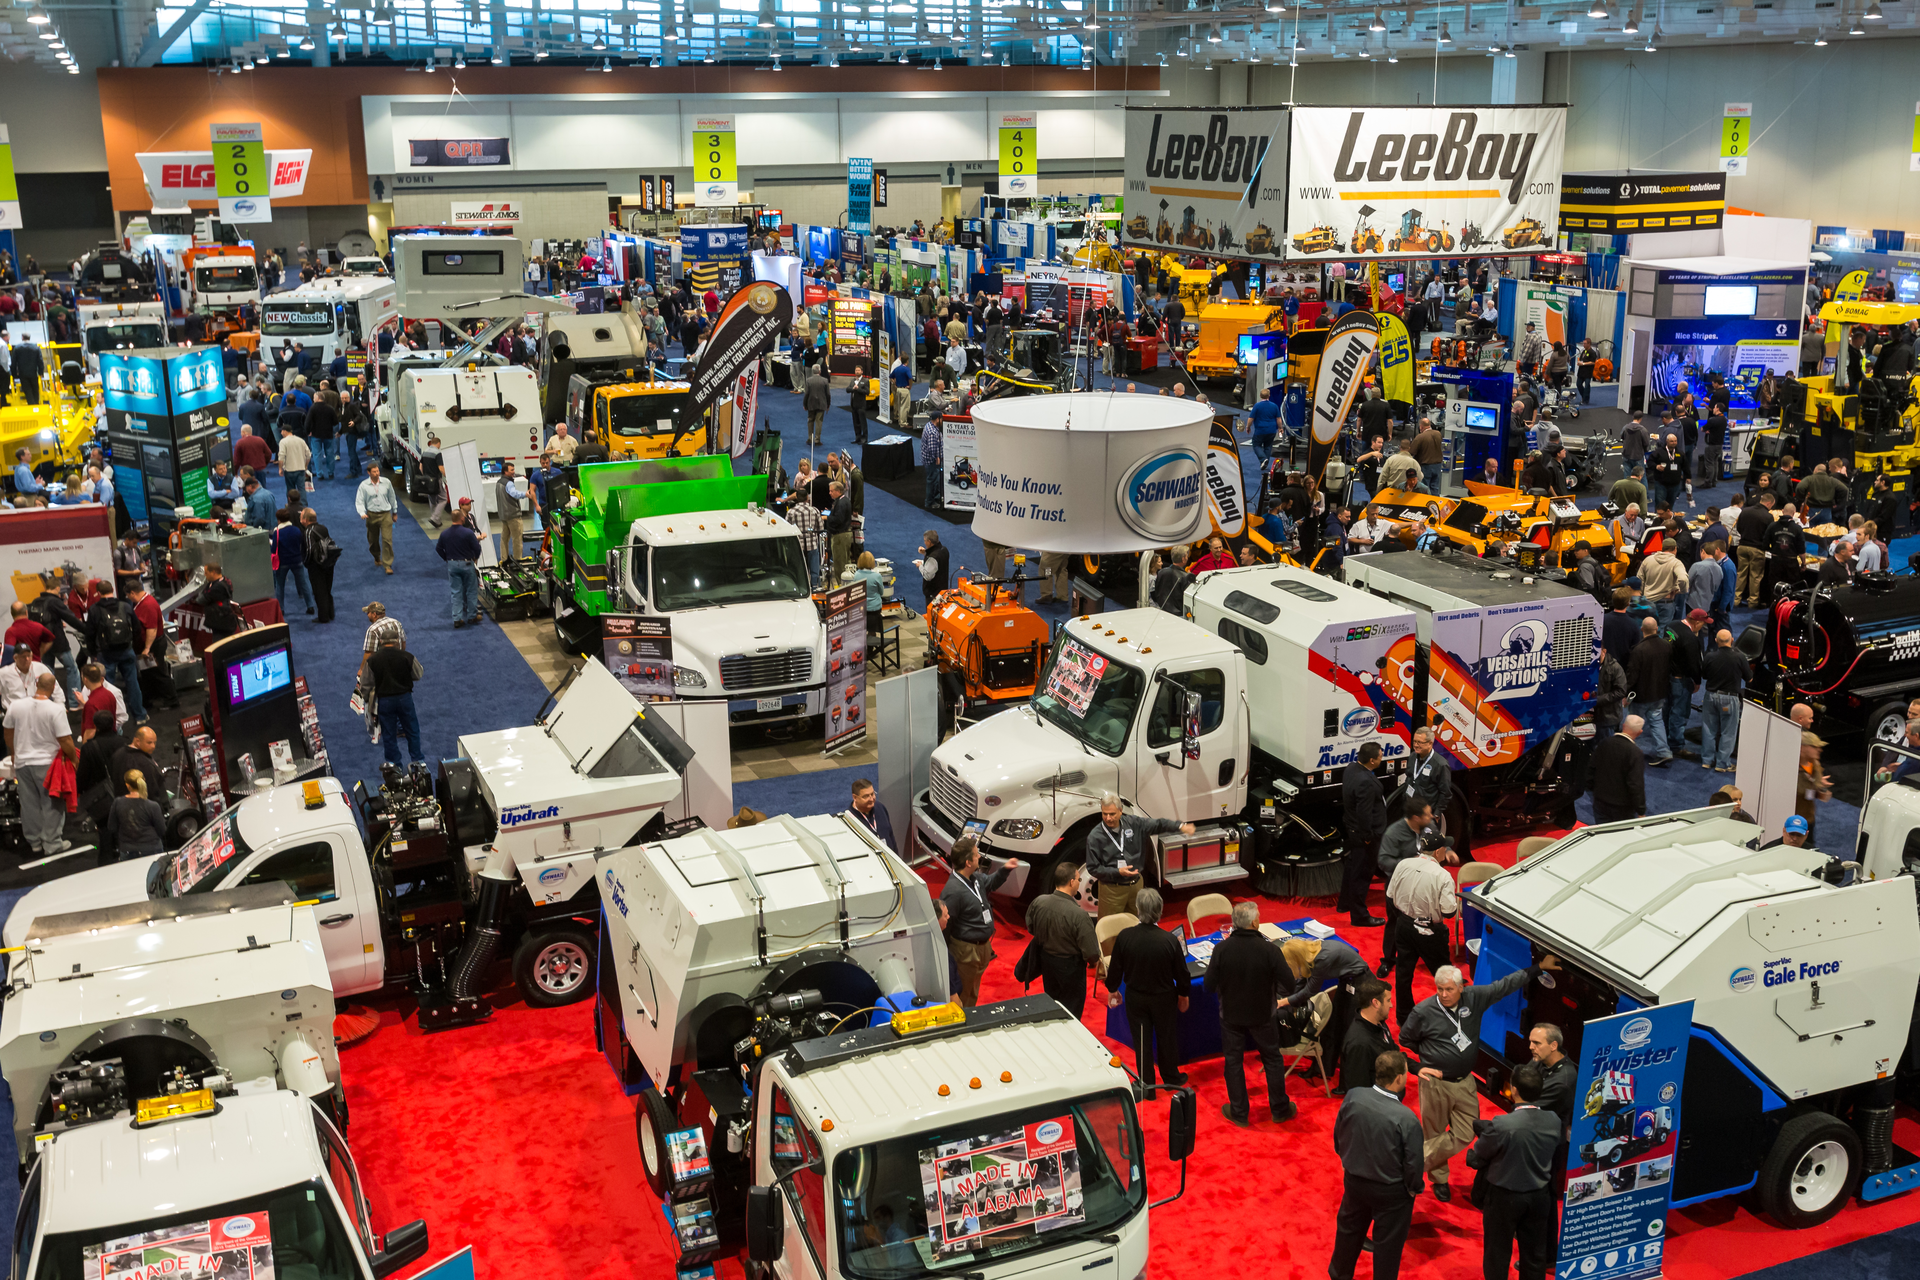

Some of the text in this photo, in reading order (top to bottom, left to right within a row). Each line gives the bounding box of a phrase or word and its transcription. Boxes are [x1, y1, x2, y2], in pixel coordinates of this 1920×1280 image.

[444, 141, 484, 159] QPR
[708, 134, 721, 180] 300
[1012, 130, 1023, 173] 400
[1333, 112, 1538, 204] LeeBoy
[231, 144, 250, 194] 200
[849, 158, 872, 166] WIN
[1145, 113, 1268, 208] LeeBoy
[161, 164, 216, 188] ELG
[273, 160, 305, 186] ELGIN
[397, 175, 434, 184] WOMEN
[849, 172, 871, 180] WORK
[645, 181, 654, 211] CASE
[664, 181, 674, 211] CASE
[850, 183, 872, 191] SAVE
[879, 174, 887, 205] CASE
[1260, 187, 1281, 201] .com
[1300, 187, 1334, 200] www.
[1525, 181, 1554, 195] .com
[455, 211, 520, 220] STEWART-AMOS
[1031, 272, 1059, 280] NEYRA
[1533, 292, 1557, 300] Billy Goat
[267, 312, 328, 323] NEW Chassis!
[1844, 308, 1869, 316] BOMAG
[1675, 332, 1719, 341] Nice Stripes.
[695, 316, 781, 403] HEAT DESIGN EQUIPMENT INC.
[1382, 339, 1410, 369] 25
[1315, 335, 1371, 423] LeeBoy
[739, 369, 755, 443] STEWART-AMOS
[189, 411, 203, 423] Black
[979, 465, 1063, 496] People You Know.
[1134, 471, 1201, 503] SCHWARZE
[1006, 501, 1026, 518] You
[1030, 504, 1067, 523] Trust.
[1503, 607, 1519, 615] Stand
[1523, 604, 1544, 612] Chance
[1329, 635, 1345, 643] With
[1371, 623, 1387, 636] Six
[1487, 651, 1549, 673] VERSATILE
[230, 673, 240, 699] TITAN
[1493, 666, 1548, 689] OPTIONS
[183, 718, 200, 729] TITAN
[1345, 715, 1376, 727] SCHWARZE
[1506, 728, 1534, 738] Conveyor
[1319, 744, 1334, 753] M6
[500, 805, 560, 826] Updraft
[611, 885, 630, 919] Vortex
[1763, 957, 1792, 969] SuperVac
[1731, 972, 1755, 985] SCHWARZE
[1763, 959, 1840, 988] Gale Force
[1594, 1045, 1613, 1059] A8
[1592, 1046, 1679, 1080] Twister
[957, 1161, 1039, 1198] MADE IN
[961, 1184, 1046, 1221] ALABAMA
[1565, 1216, 1580, 1225] Large
[1581, 1213, 1599, 1221] Access
[1623, 1202, 1640, 1211] Engine
[1645, 1197, 1664, 1206] System
[1589, 1204, 1604, 1212] Dump
[1604, 1198, 1623, 1207] Scissor
[1563, 1233, 1581, 1241] Proven
[1598, 1225, 1612, 1233] Drive
[1622, 1218, 1641, 1227] System
[1569, 1224, 1584, 1232] Cubic
[1597, 1217, 1614, 1225] Debris
[1614, 1212, 1633, 1221] Hopper
[1573, 1239, 1589, 1247] Dump
[1589, 1234, 1610, 1243] Without
[1610, 1227, 1637, 1238] Stabilizers
[1577, 1246, 1590, 1254] Final
[1590, 1242, 1611, 1251] Auxiliary
[1611, 1237, 1629, 1246] Engine
[198, 1254, 223, 1272] IN
